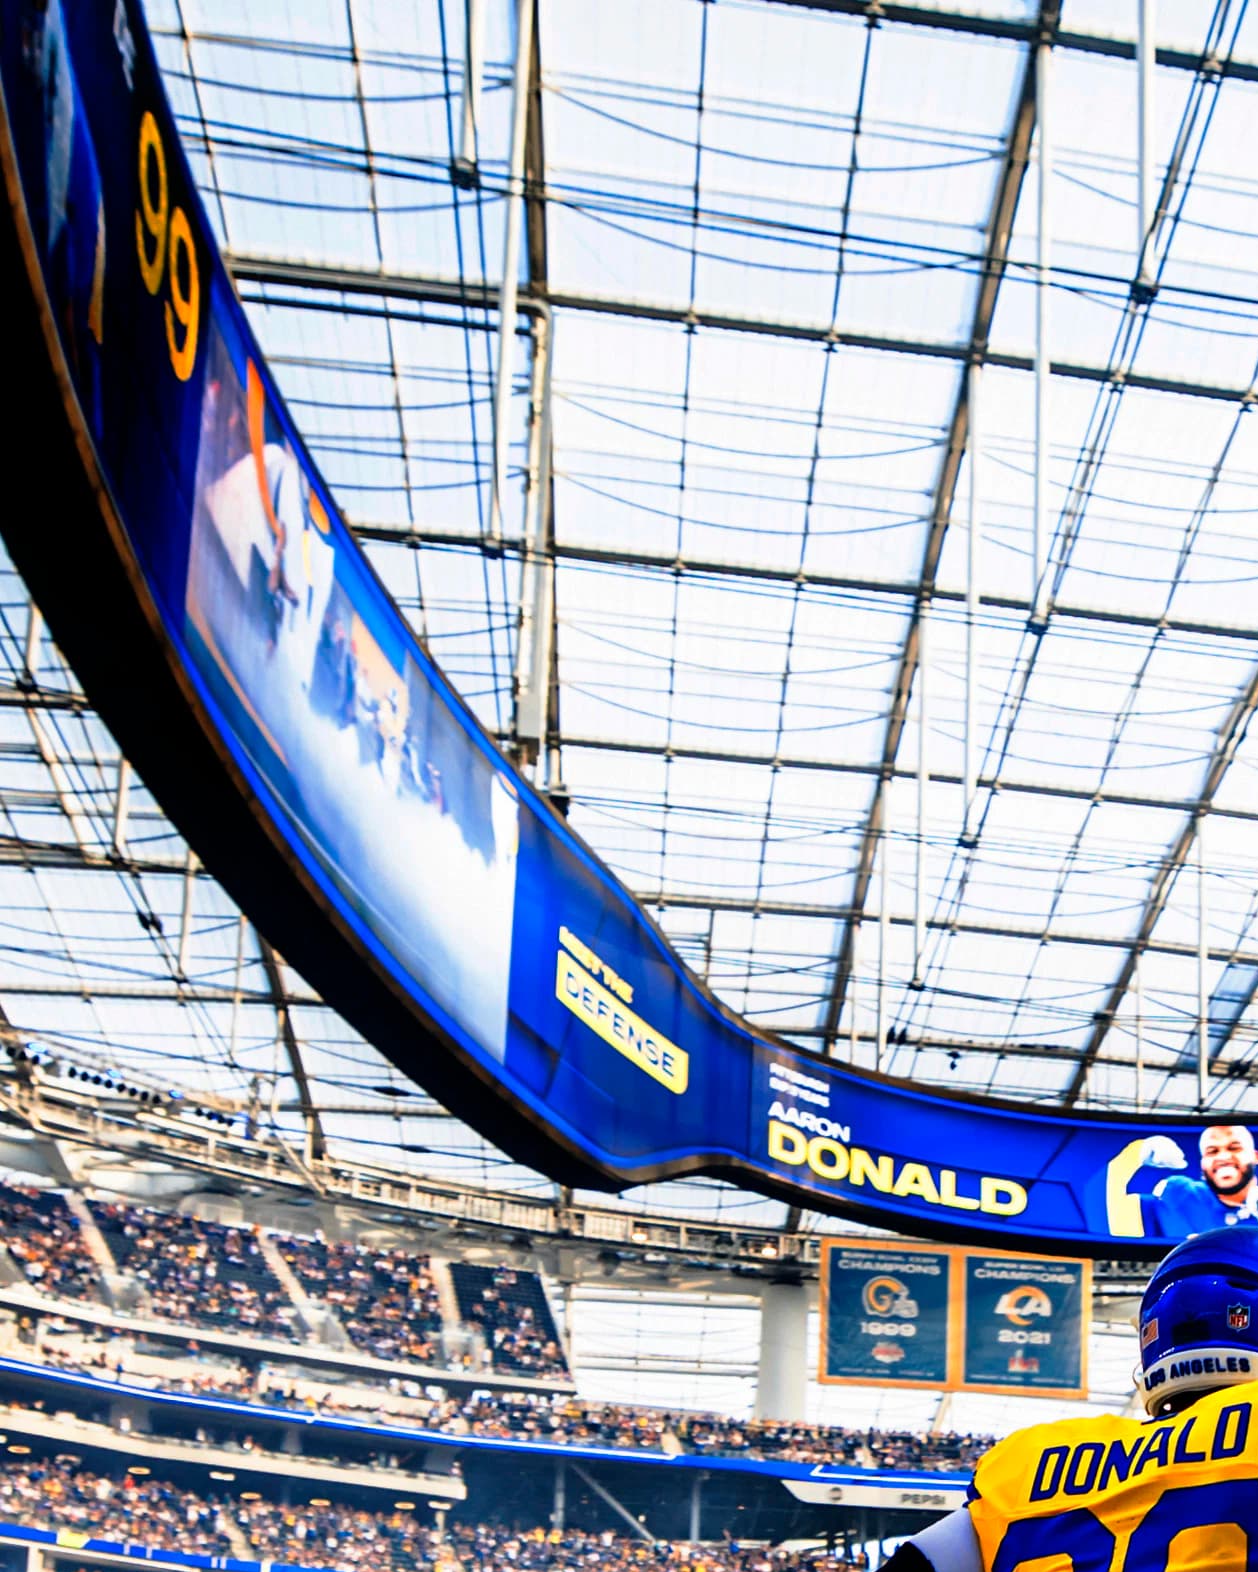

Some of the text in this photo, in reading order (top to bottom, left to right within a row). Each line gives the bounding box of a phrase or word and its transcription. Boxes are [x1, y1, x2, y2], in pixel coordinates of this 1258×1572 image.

[136, 111, 200, 381] 99
[566, 970, 676, 1078] DEFENSE
[768, 1101, 850, 1143] AARON
[768, 1119, 1027, 1215] DONALD
[998, 1330, 1051, 1344] 2021
[1144, 1357, 1251, 1391] LOS ANGELES
[1029, 1402, 1252, 1502] DONALD
[901, 1493, 945, 1505] PEPSI
